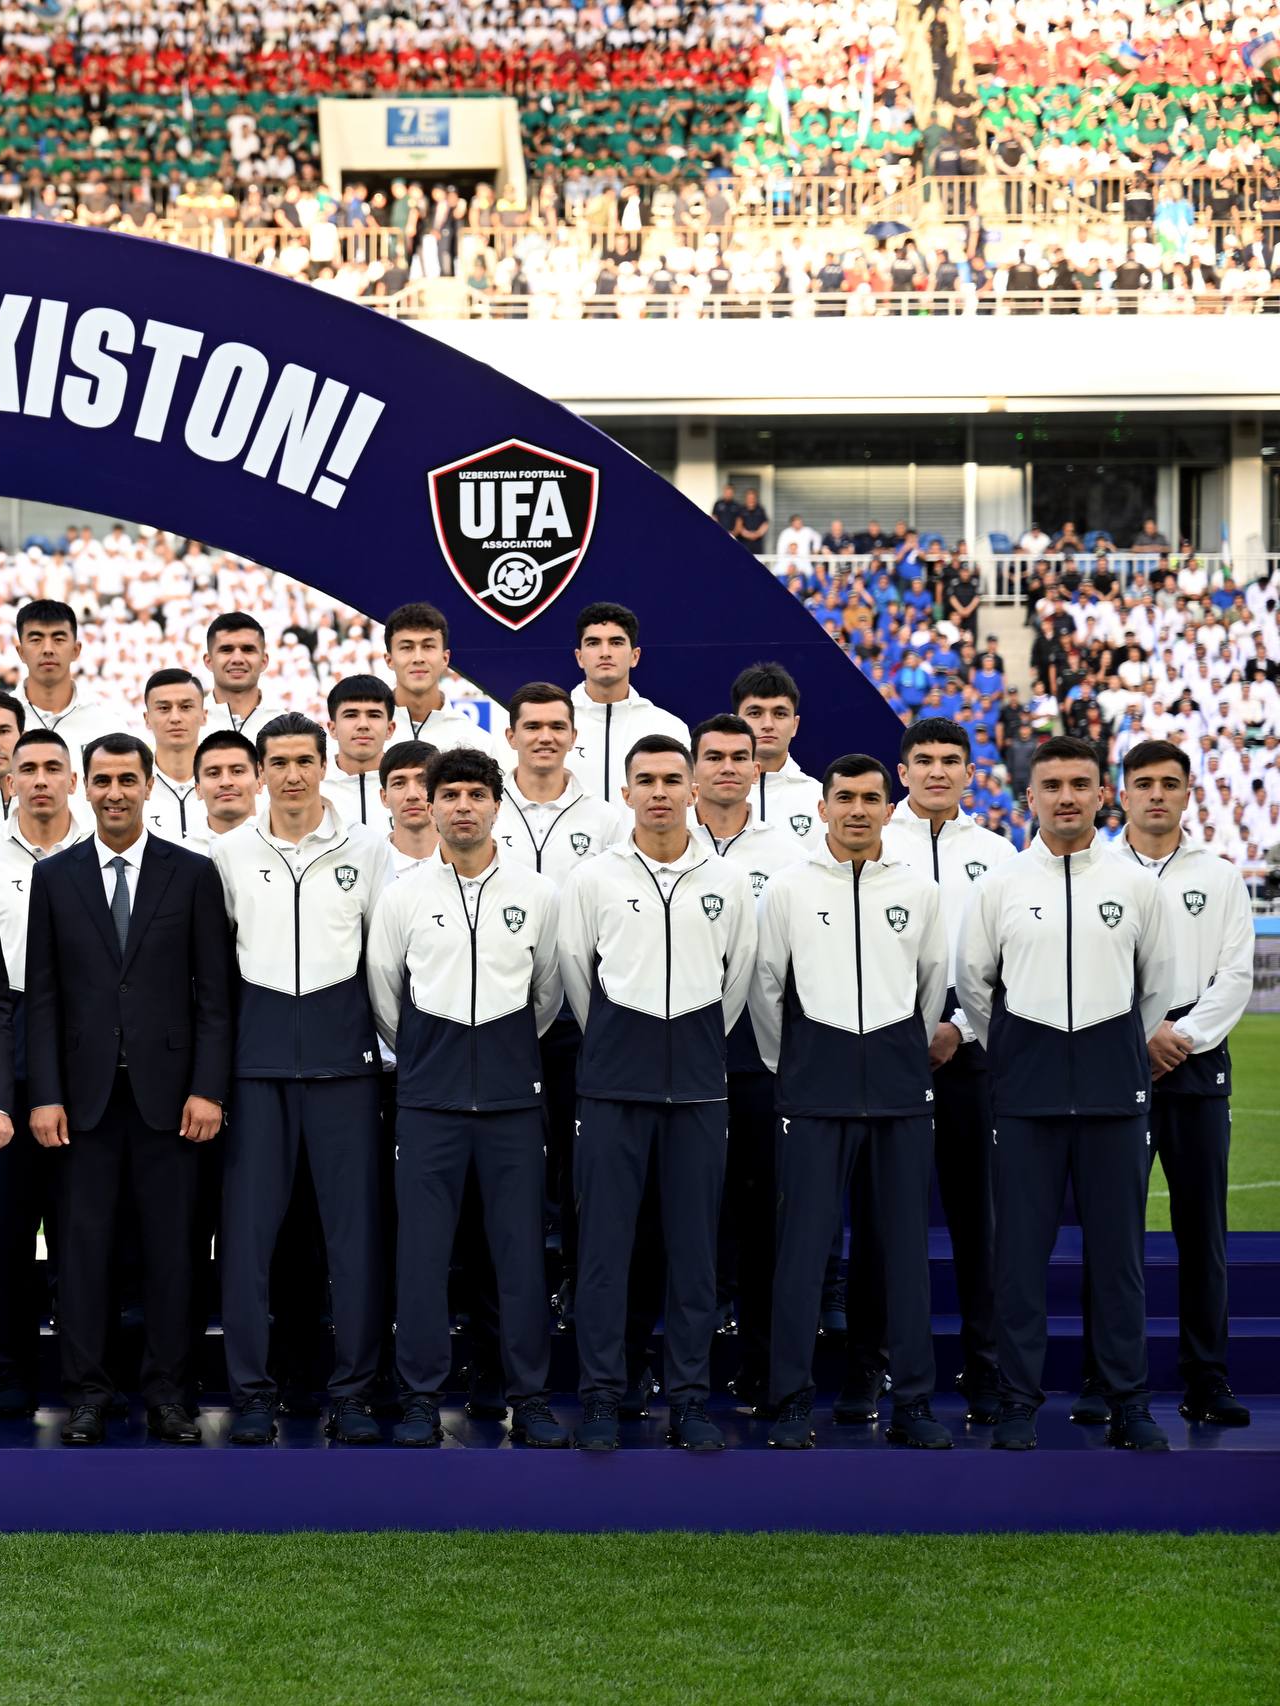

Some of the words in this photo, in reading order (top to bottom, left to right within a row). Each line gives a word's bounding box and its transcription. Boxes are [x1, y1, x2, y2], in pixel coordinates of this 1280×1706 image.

[459, 471, 517, 479] UZBEKISTAN
[519, 470, 566, 479] FOOTBALL
[459, 480, 573, 539] UFA
[482, 540, 552, 549] ASSOCIATION
[792, 817, 809, 828] UFA
[572, 835, 588, 847] UFA
[337, 869, 355, 881] UFA
[704, 898, 721, 910] UFA
[1186, 894, 1203, 906] UFA
[506, 909, 523, 922] UFA
[889, 910, 906, 922] UFA
[1102, 905, 1119, 917] UFA
[363, 1050, 373, 1063] 14
[1135, 1090, 1146, 1102] 35
